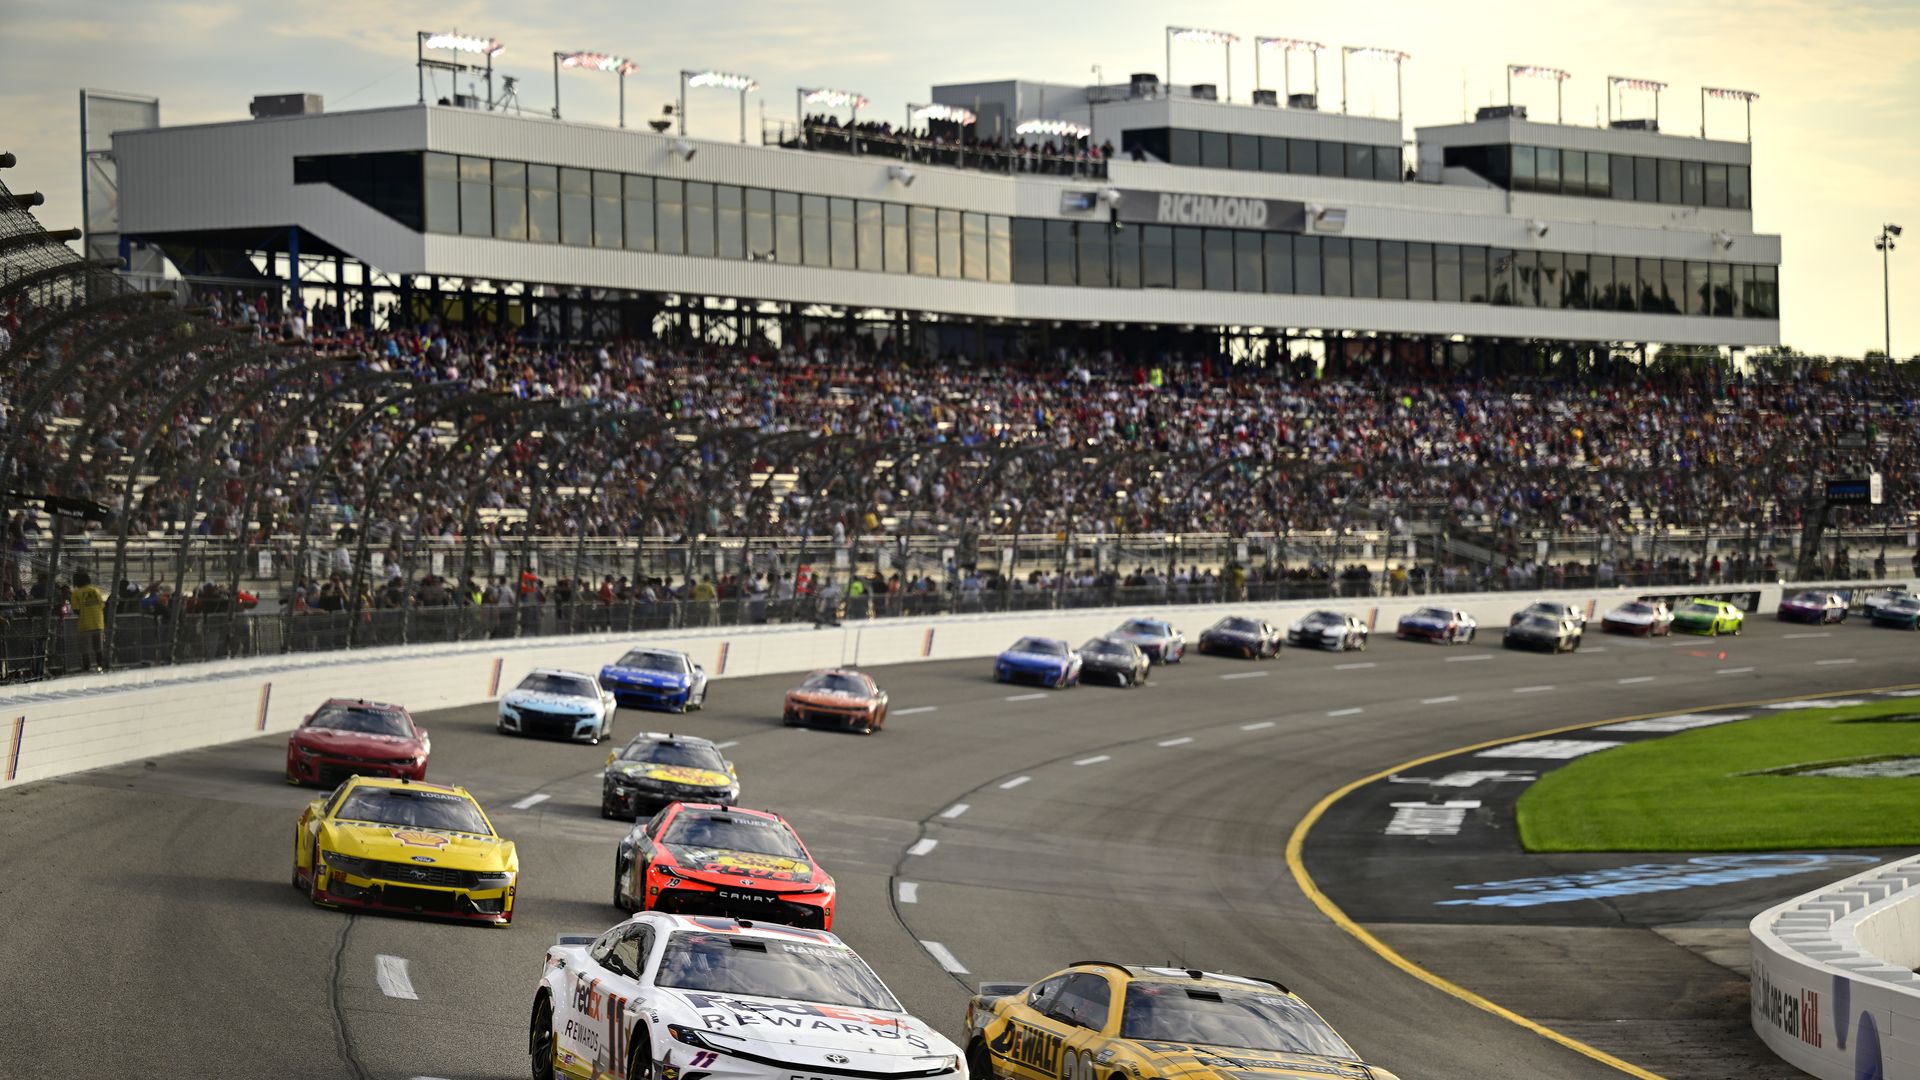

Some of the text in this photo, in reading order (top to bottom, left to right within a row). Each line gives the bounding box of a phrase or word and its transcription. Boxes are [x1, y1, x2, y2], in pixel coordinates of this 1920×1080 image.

[1156, 193, 1268, 227] RICHMOND
[420, 791, 462, 801] LOGANO
[666, 877, 681, 888] 19
[719, 891, 776, 903] CAMRY
[783, 944, 851, 960] HAMLIN
[683, 993, 918, 1031] FedEx
[1783, 993, 1799, 1037] can
[1801, 987, 1822, 1049] kill.
[564, 1019, 599, 1052] REWARDS
[607, 992, 628, 1079] 11
[702, 1013, 930, 1050] REWARDS
[689, 1051, 719, 1069] 11
